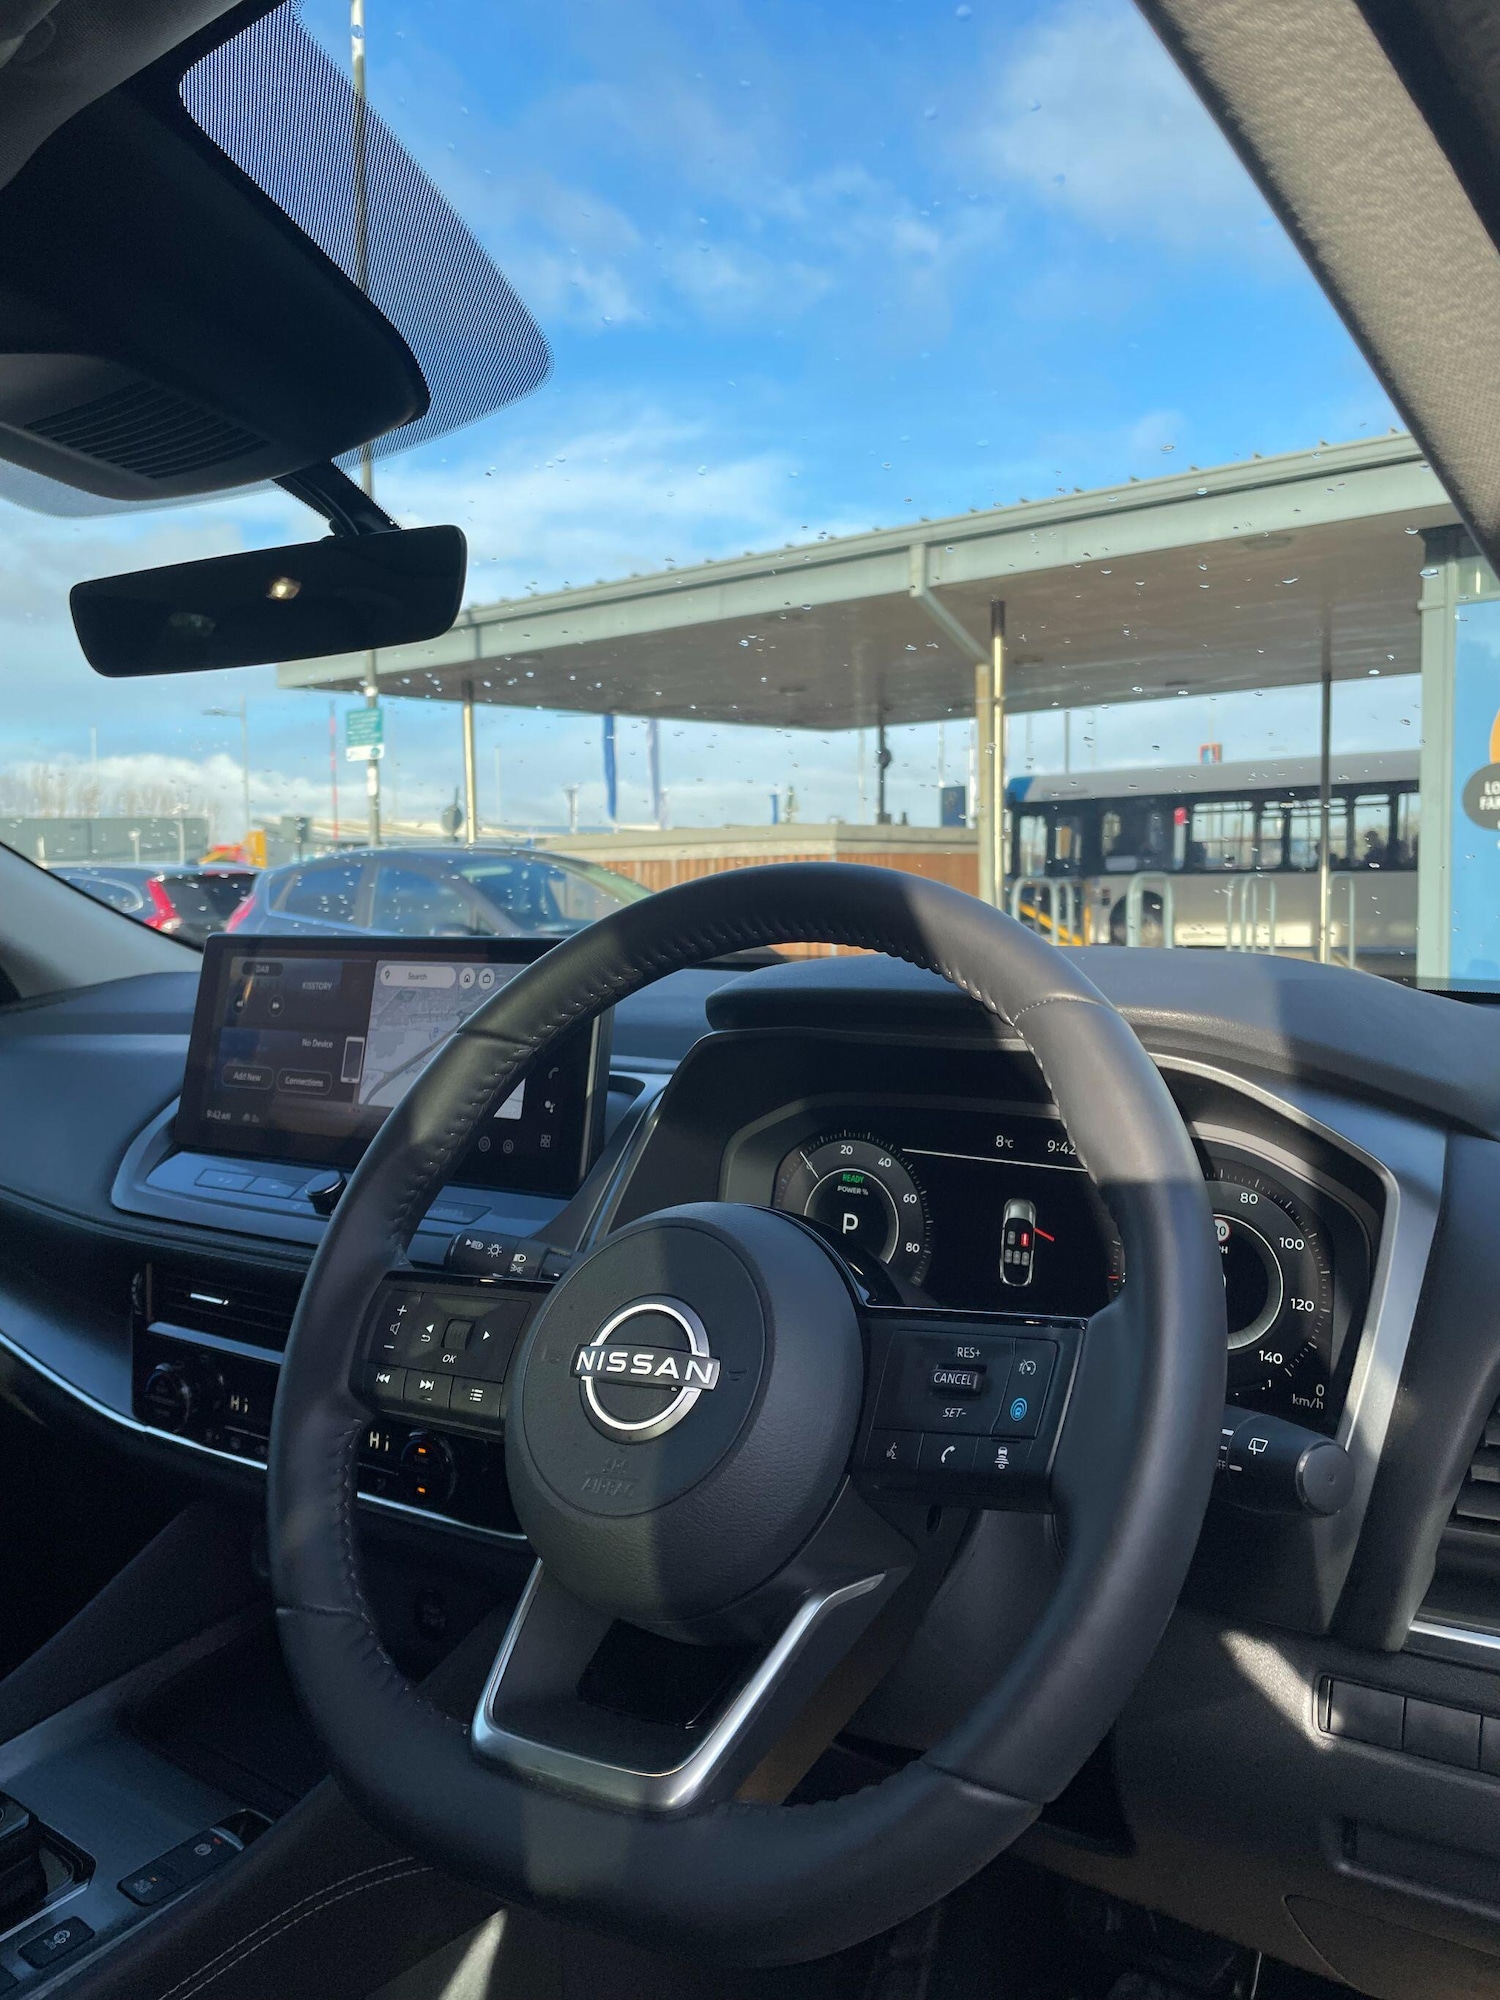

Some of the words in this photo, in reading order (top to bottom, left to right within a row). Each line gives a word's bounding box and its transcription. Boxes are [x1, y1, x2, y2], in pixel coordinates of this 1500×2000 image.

[408, 972, 427, 981] Search
[302, 981, 333, 991] KISSTORY
[302, 1038, 312, 1047] No
[313, 1039, 333, 1049] Device
[233, 1071, 247, 1081] Add
[247, 1072, 262, 1082] New
[285, 1076, 324, 1088] Connections
[840, 1145, 853, 1155] 20
[878, 1158, 892, 1168] 40
[842, 1173, 865, 1184] READY
[837, 1185, 861, 1194] POWER
[903, 1193, 917, 1204] 60
[1240, 1193, 1258, 1205] 80
[842, 1213, 859, 1234] P
[905, 1242, 920, 1254] 80
[1279, 1237, 1304, 1251] 100
[1290, 1298, 1315, 1313] 120
[442, 1354, 457, 1364] OK
[957, 1347, 981, 1359] RES+
[1259, 1350, 1283, 1365] 140
[575, 1351, 714, 1385] NISSAN
[933, 1372, 972, 1386] CANCEL
[1315, 1383, 1325, 1397] 0
[230, 1394, 249, 1414] Hi
[1292, 1393, 1324, 1410] km/h
[942, 1407, 967, 1418] SET-
[369, 1430, 390, 1452] Hi
